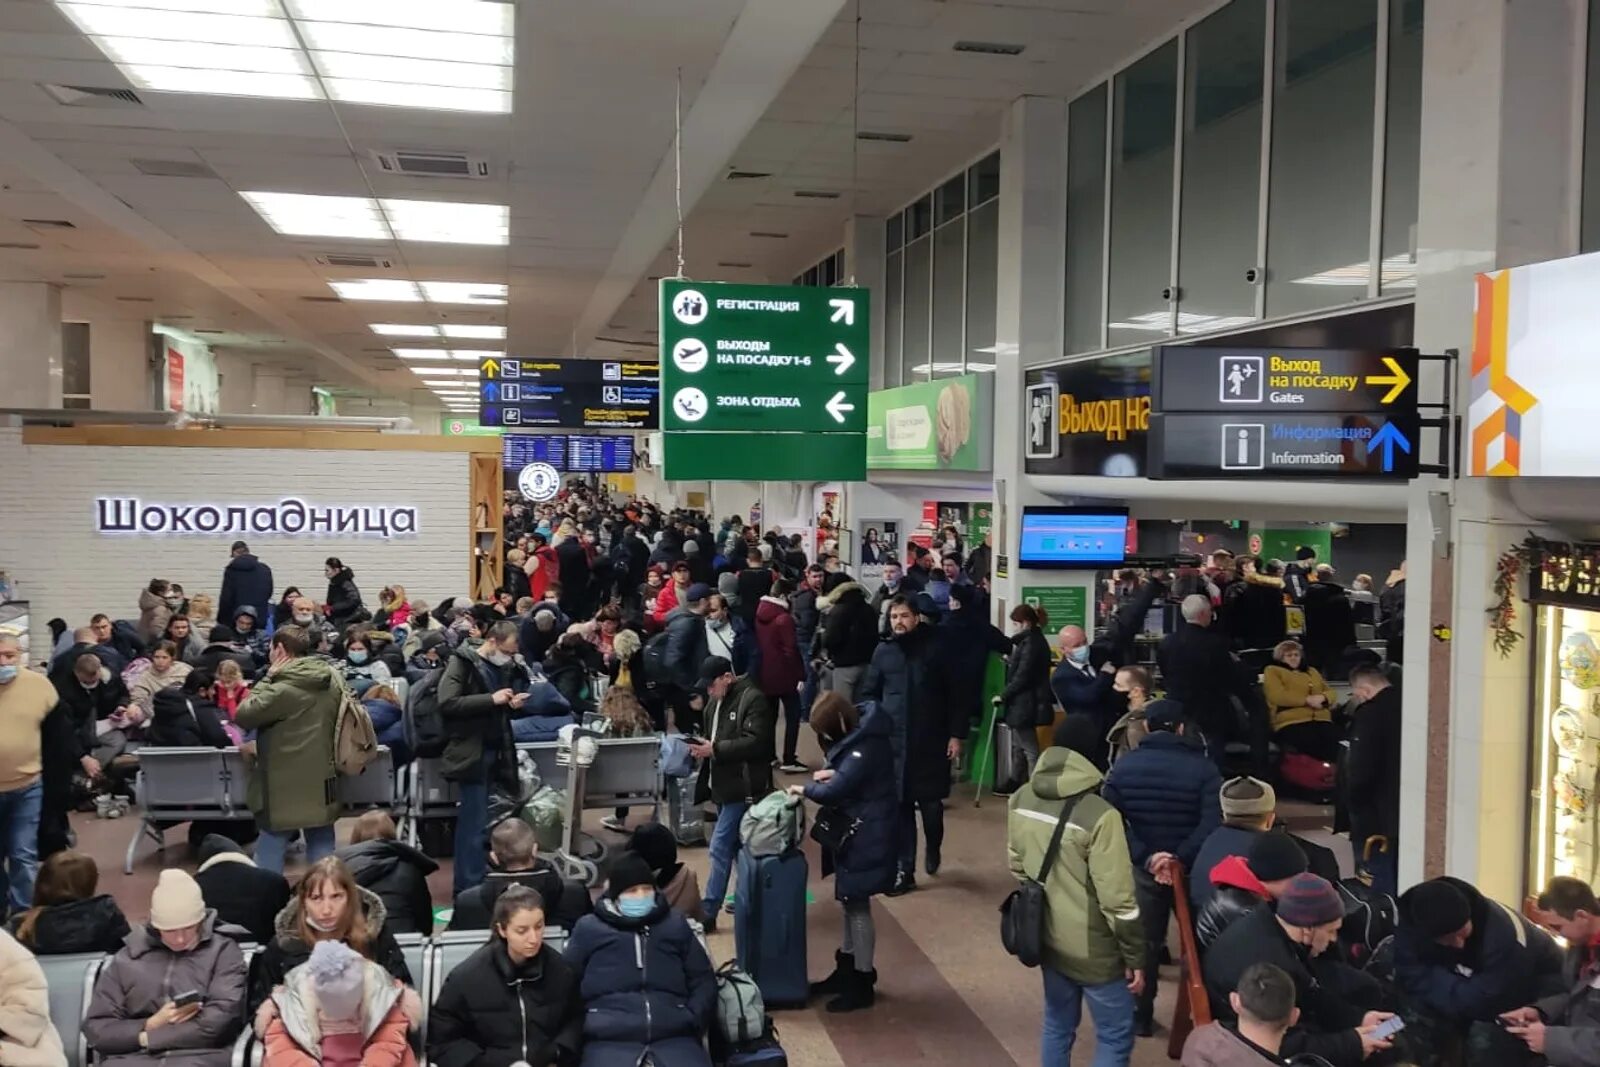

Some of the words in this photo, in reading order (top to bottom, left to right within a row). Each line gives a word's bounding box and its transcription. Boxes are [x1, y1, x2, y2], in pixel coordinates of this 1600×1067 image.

[717, 299, 800, 312] РЕГИСТРАЦИЯ
[717, 340, 770, 352] ВЫХОДЫ
[717, 354, 733, 364] НА
[736, 355, 792, 366] ПОСАДКУ
[794, 356, 812, 366] 1-6
[1270, 356, 1321, 374] Выход
[1270, 376, 1289, 387] на
[1293, 375, 1358, 391] посадку
[717, 396, 749, 406] ЗОНА
[751, 397, 801, 407] ОТДЫХА
[1269, 391, 1304, 403] Gates
[1058, 393, 1125, 441] Выход
[1126, 396, 1151, 431] на
[1272, 423, 1372, 441] Информация
[1272, 451, 1345, 464] Information
[97, 499, 416, 536] Шоколадница
